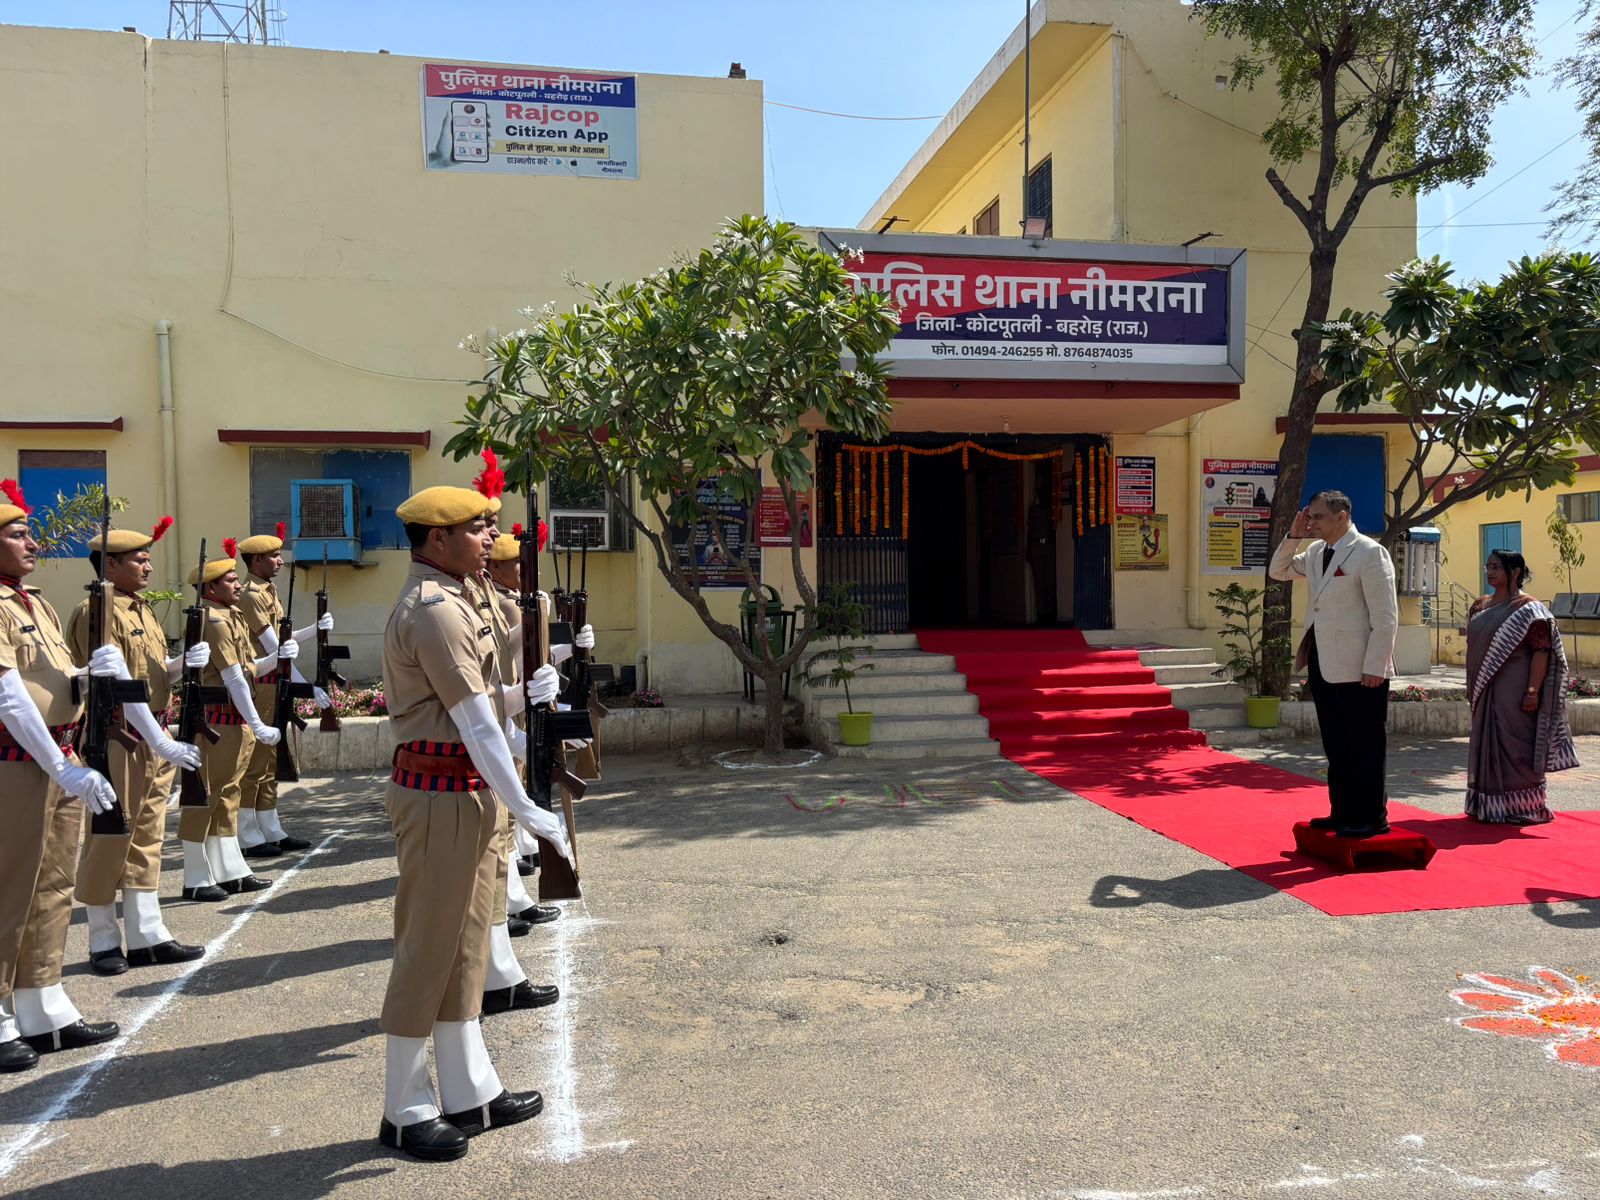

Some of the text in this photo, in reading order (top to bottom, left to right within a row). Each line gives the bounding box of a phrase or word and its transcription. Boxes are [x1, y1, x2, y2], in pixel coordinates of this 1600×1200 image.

[439, 69, 622, 94] पुलिस थाना नीमराना
[498, 90, 537, 99] कोटपूतली
[505, 103, 600, 127] Rajcop
[505, 125, 609, 143] Citizen App
[505, 143, 526, 152] पुलिस
[569, 144, 581, 153] और
[582, 146, 605, 154] आसान
[847, 261, 1206, 314] पलिस थाना नीमराना
[966, 313, 1042, 339] कोटपूतली
[1056, 315, 1103, 338] बहरोड़
[1106, 319, 1149, 338] (राज.)
[931, 342, 1133, 358] फोन. 01494-246255 मो. 8764874035
